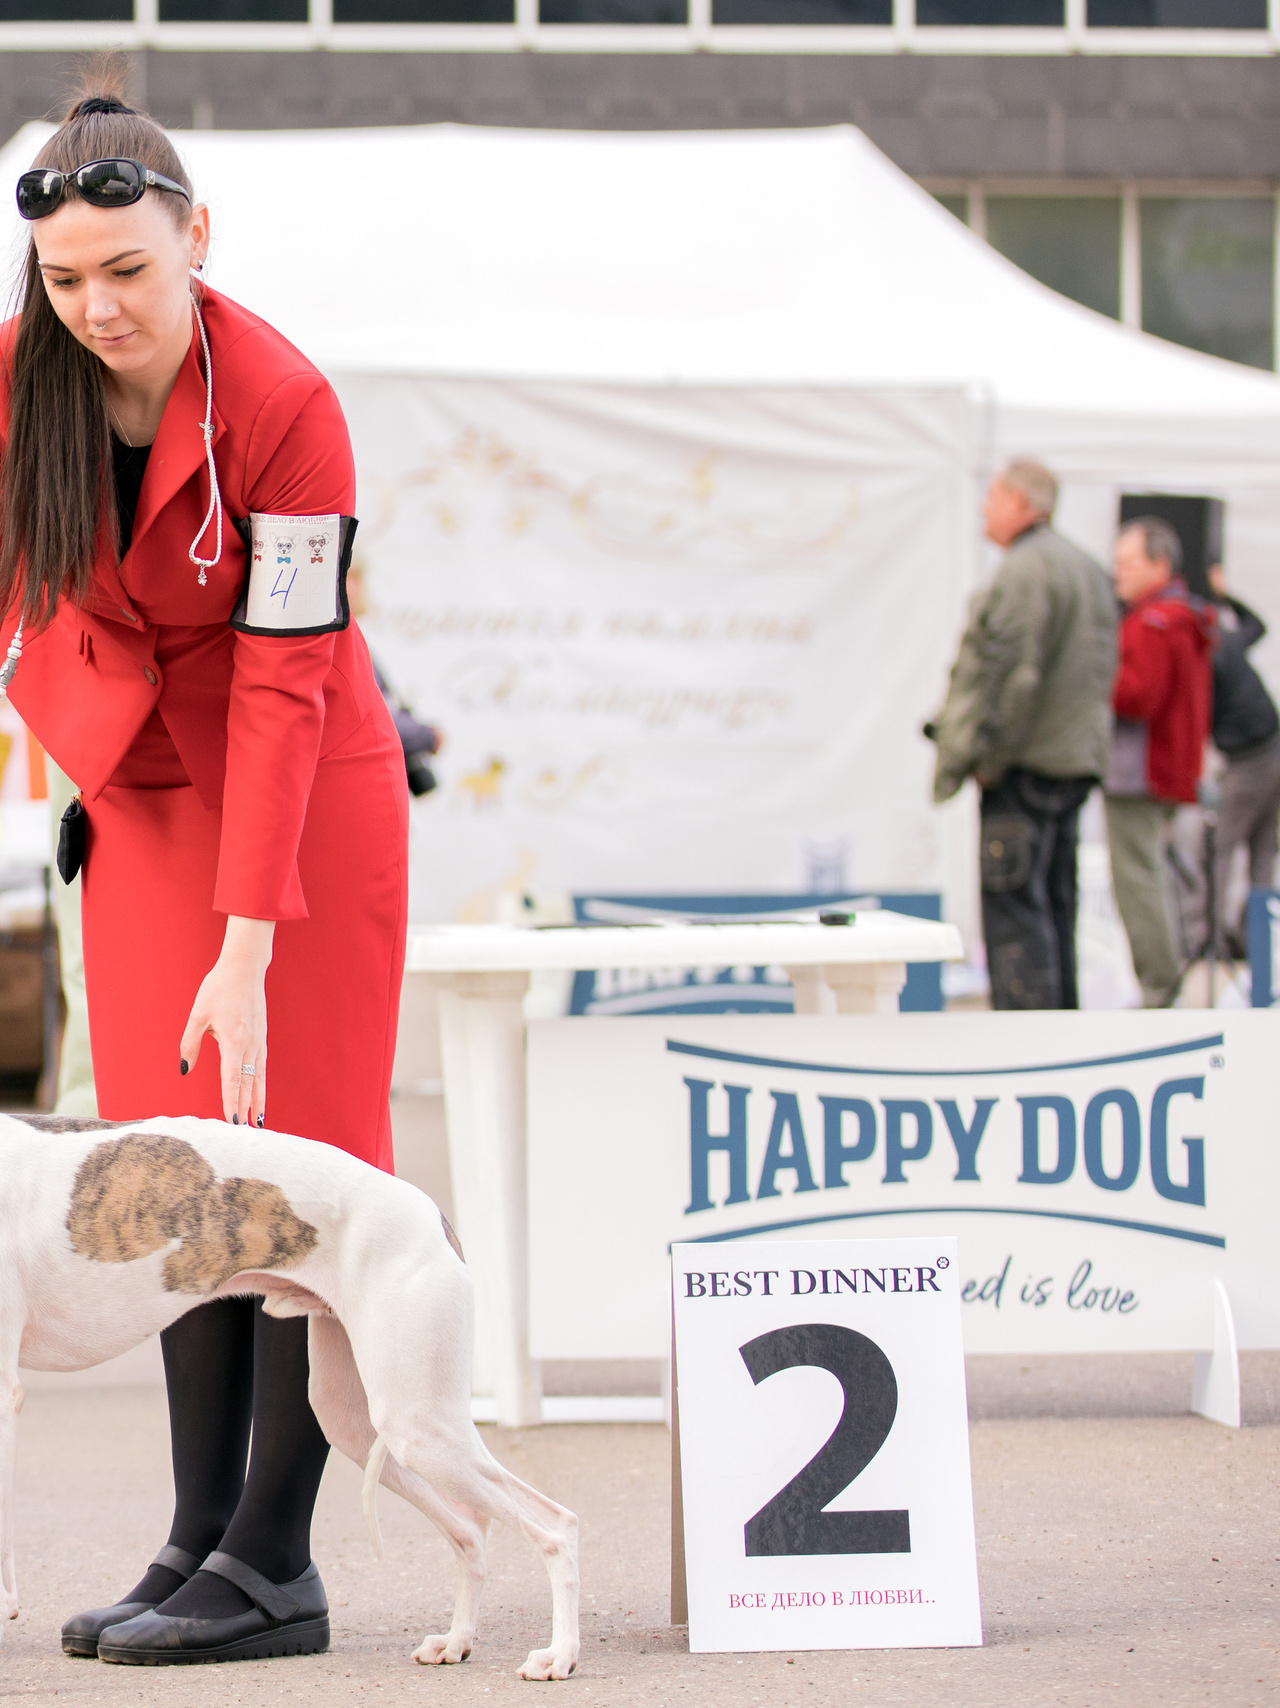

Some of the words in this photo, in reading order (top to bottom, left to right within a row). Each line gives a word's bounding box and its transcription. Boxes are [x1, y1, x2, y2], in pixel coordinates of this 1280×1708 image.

[267, 515, 286, 524] ДЕЛО
[270, 568, 298, 609] 4
[684, 1076, 1000, 1215] HAPPY
[1017, 1075, 1206, 1208] DOG
[683, 1270, 778, 1298] BEST
[790, 1267, 942, 1295] DINNER
[961, 1256, 1011, 1309] ed
[1021, 1275, 1053, 1306] is
[1068, 1260, 1138, 1313] love
[738, 1323, 911, 1558] 2
[728, 1592, 767, 1609] ВСЕ
[771, 1591, 826, 1611] ДЕЛО
[831, 1591, 844, 1606] В
